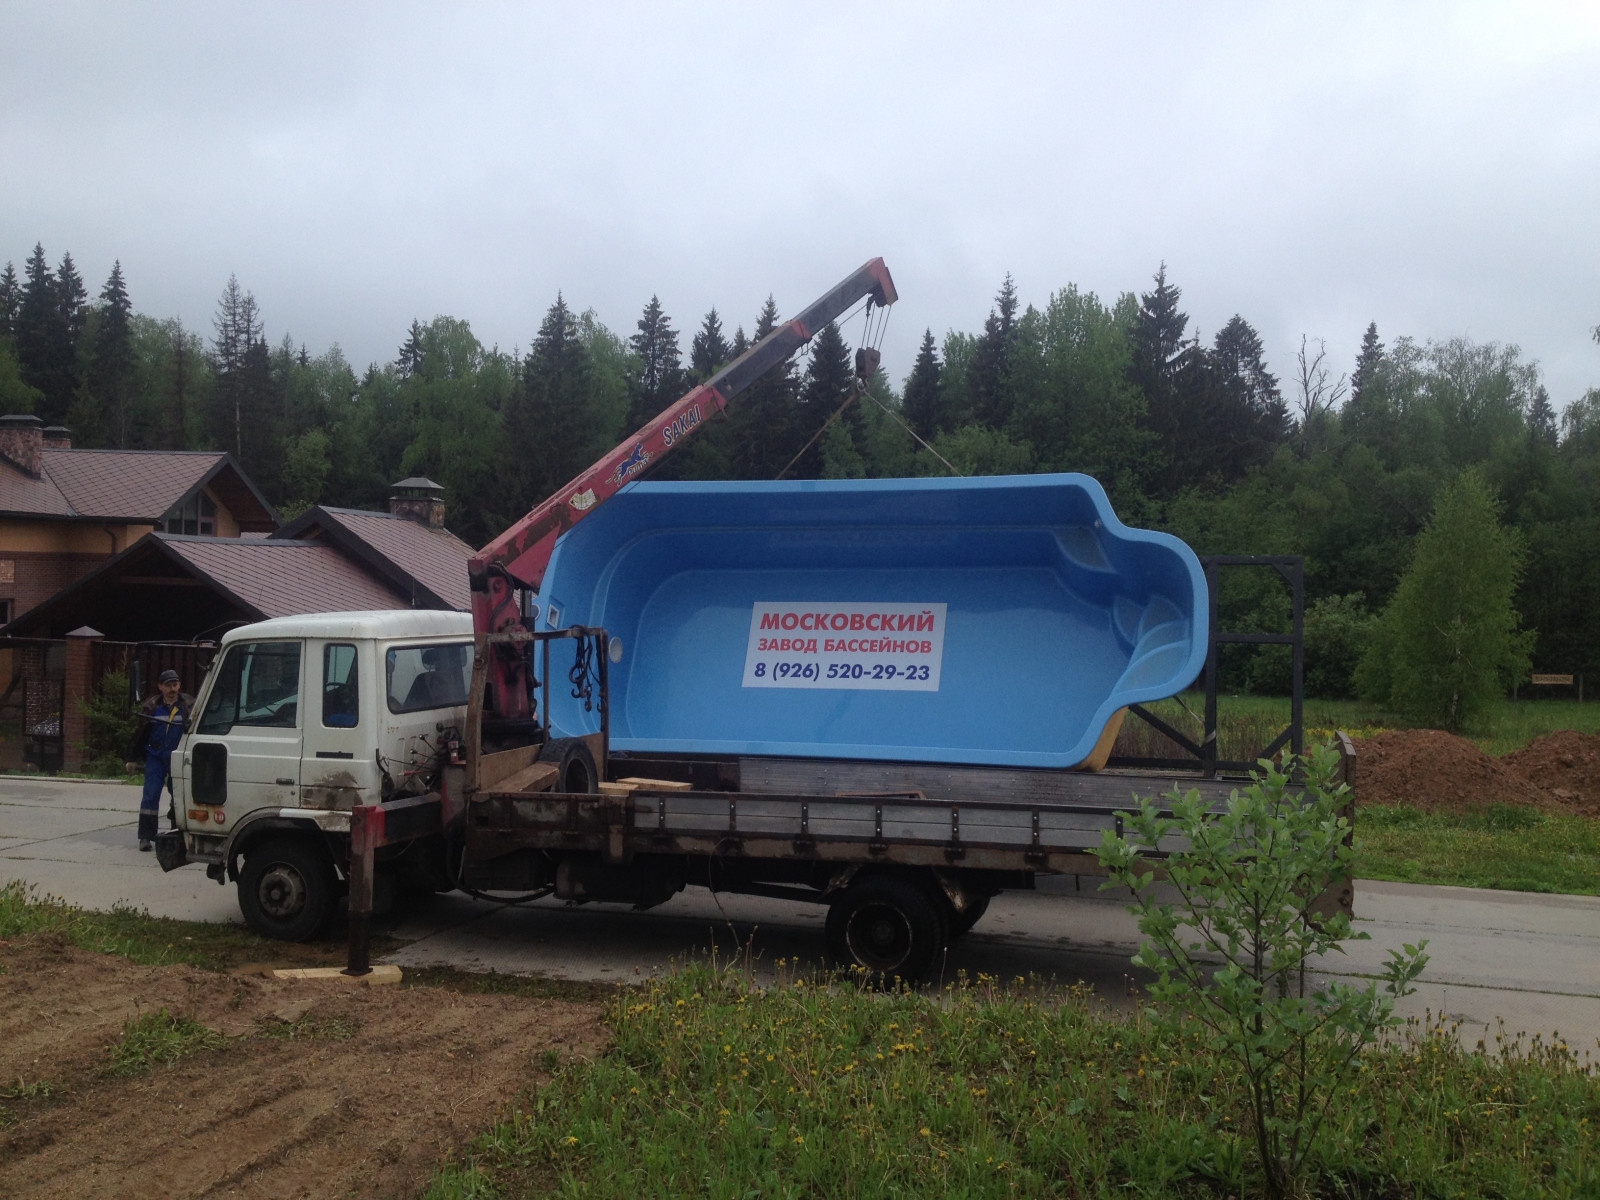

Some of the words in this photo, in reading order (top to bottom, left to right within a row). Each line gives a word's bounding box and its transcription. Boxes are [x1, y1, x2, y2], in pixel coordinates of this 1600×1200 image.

[662, 404, 702, 446] SAKAI
[759, 610, 935, 632] МОСКОВСКИЙ
[757, 638, 818, 654] ЗАВОД
[824, 636, 932, 654] БАССЕЙНОВ
[754, 662, 766, 678] 8
[772, 661, 820, 682] (926)
[826, 663, 930, 681] 520-29-23
